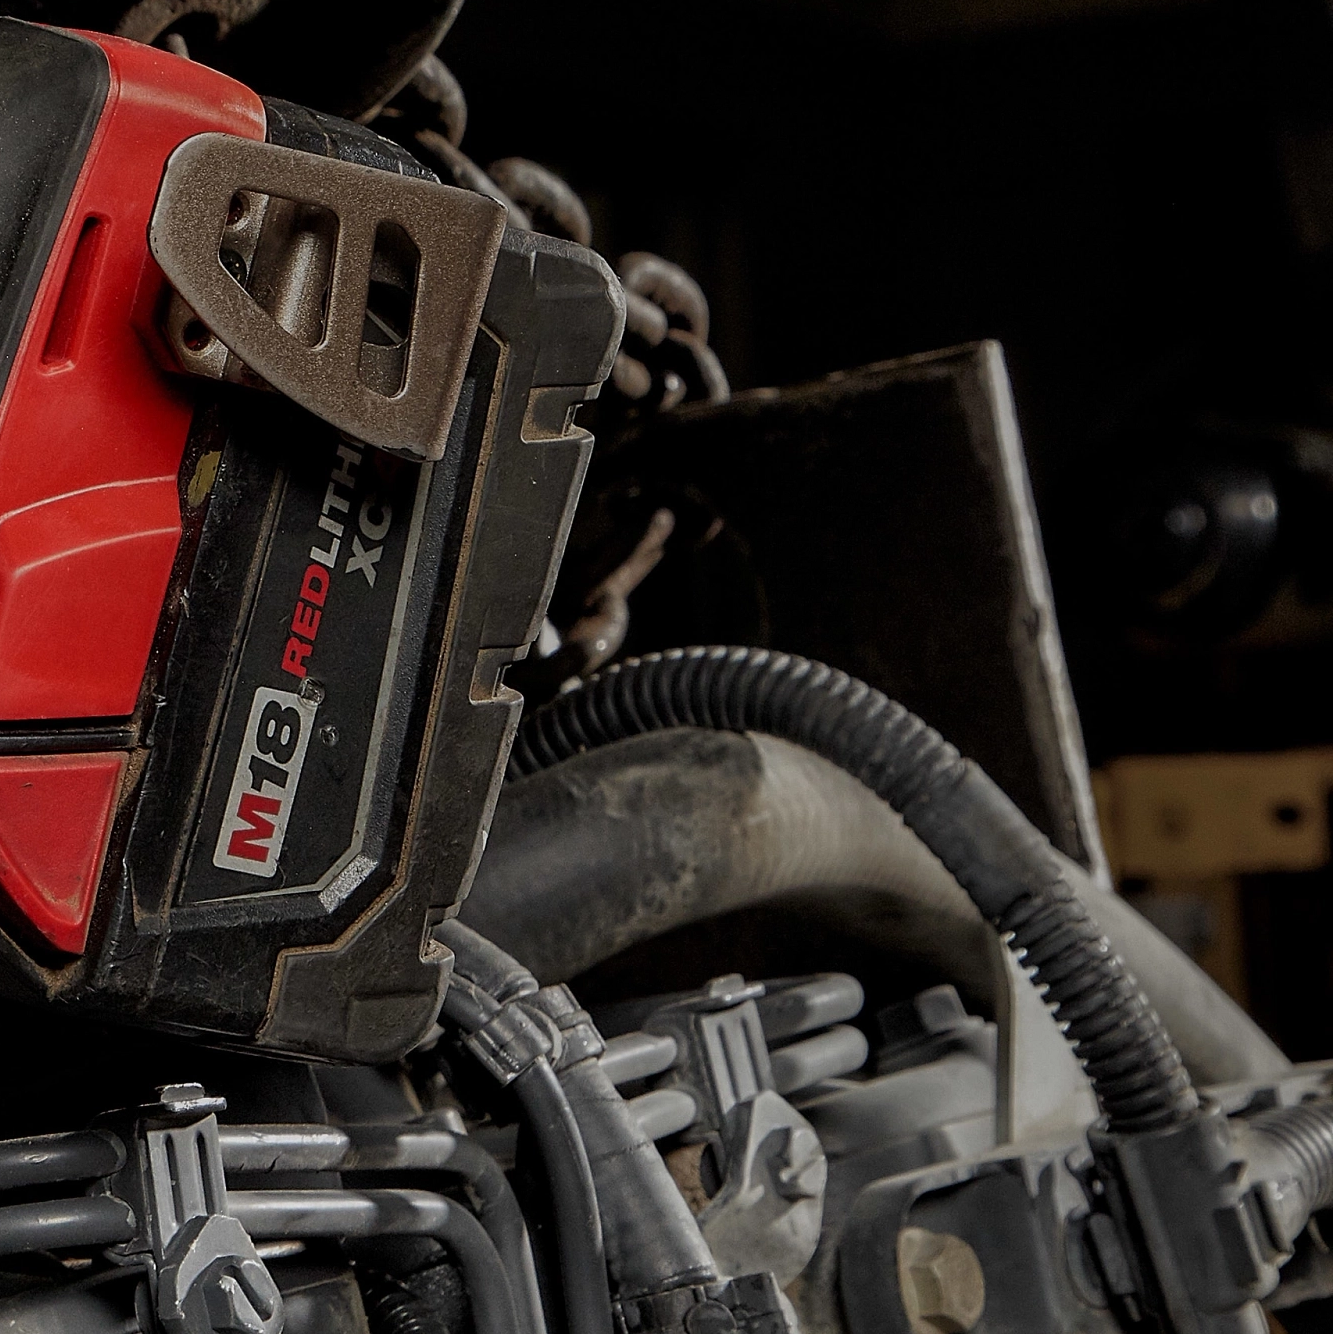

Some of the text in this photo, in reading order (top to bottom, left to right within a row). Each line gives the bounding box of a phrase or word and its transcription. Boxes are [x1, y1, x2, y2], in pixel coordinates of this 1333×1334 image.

[281, 441, 367, 678] REDLITH
[345, 493, 393, 588] XC
[227, 700, 302, 862] M18
